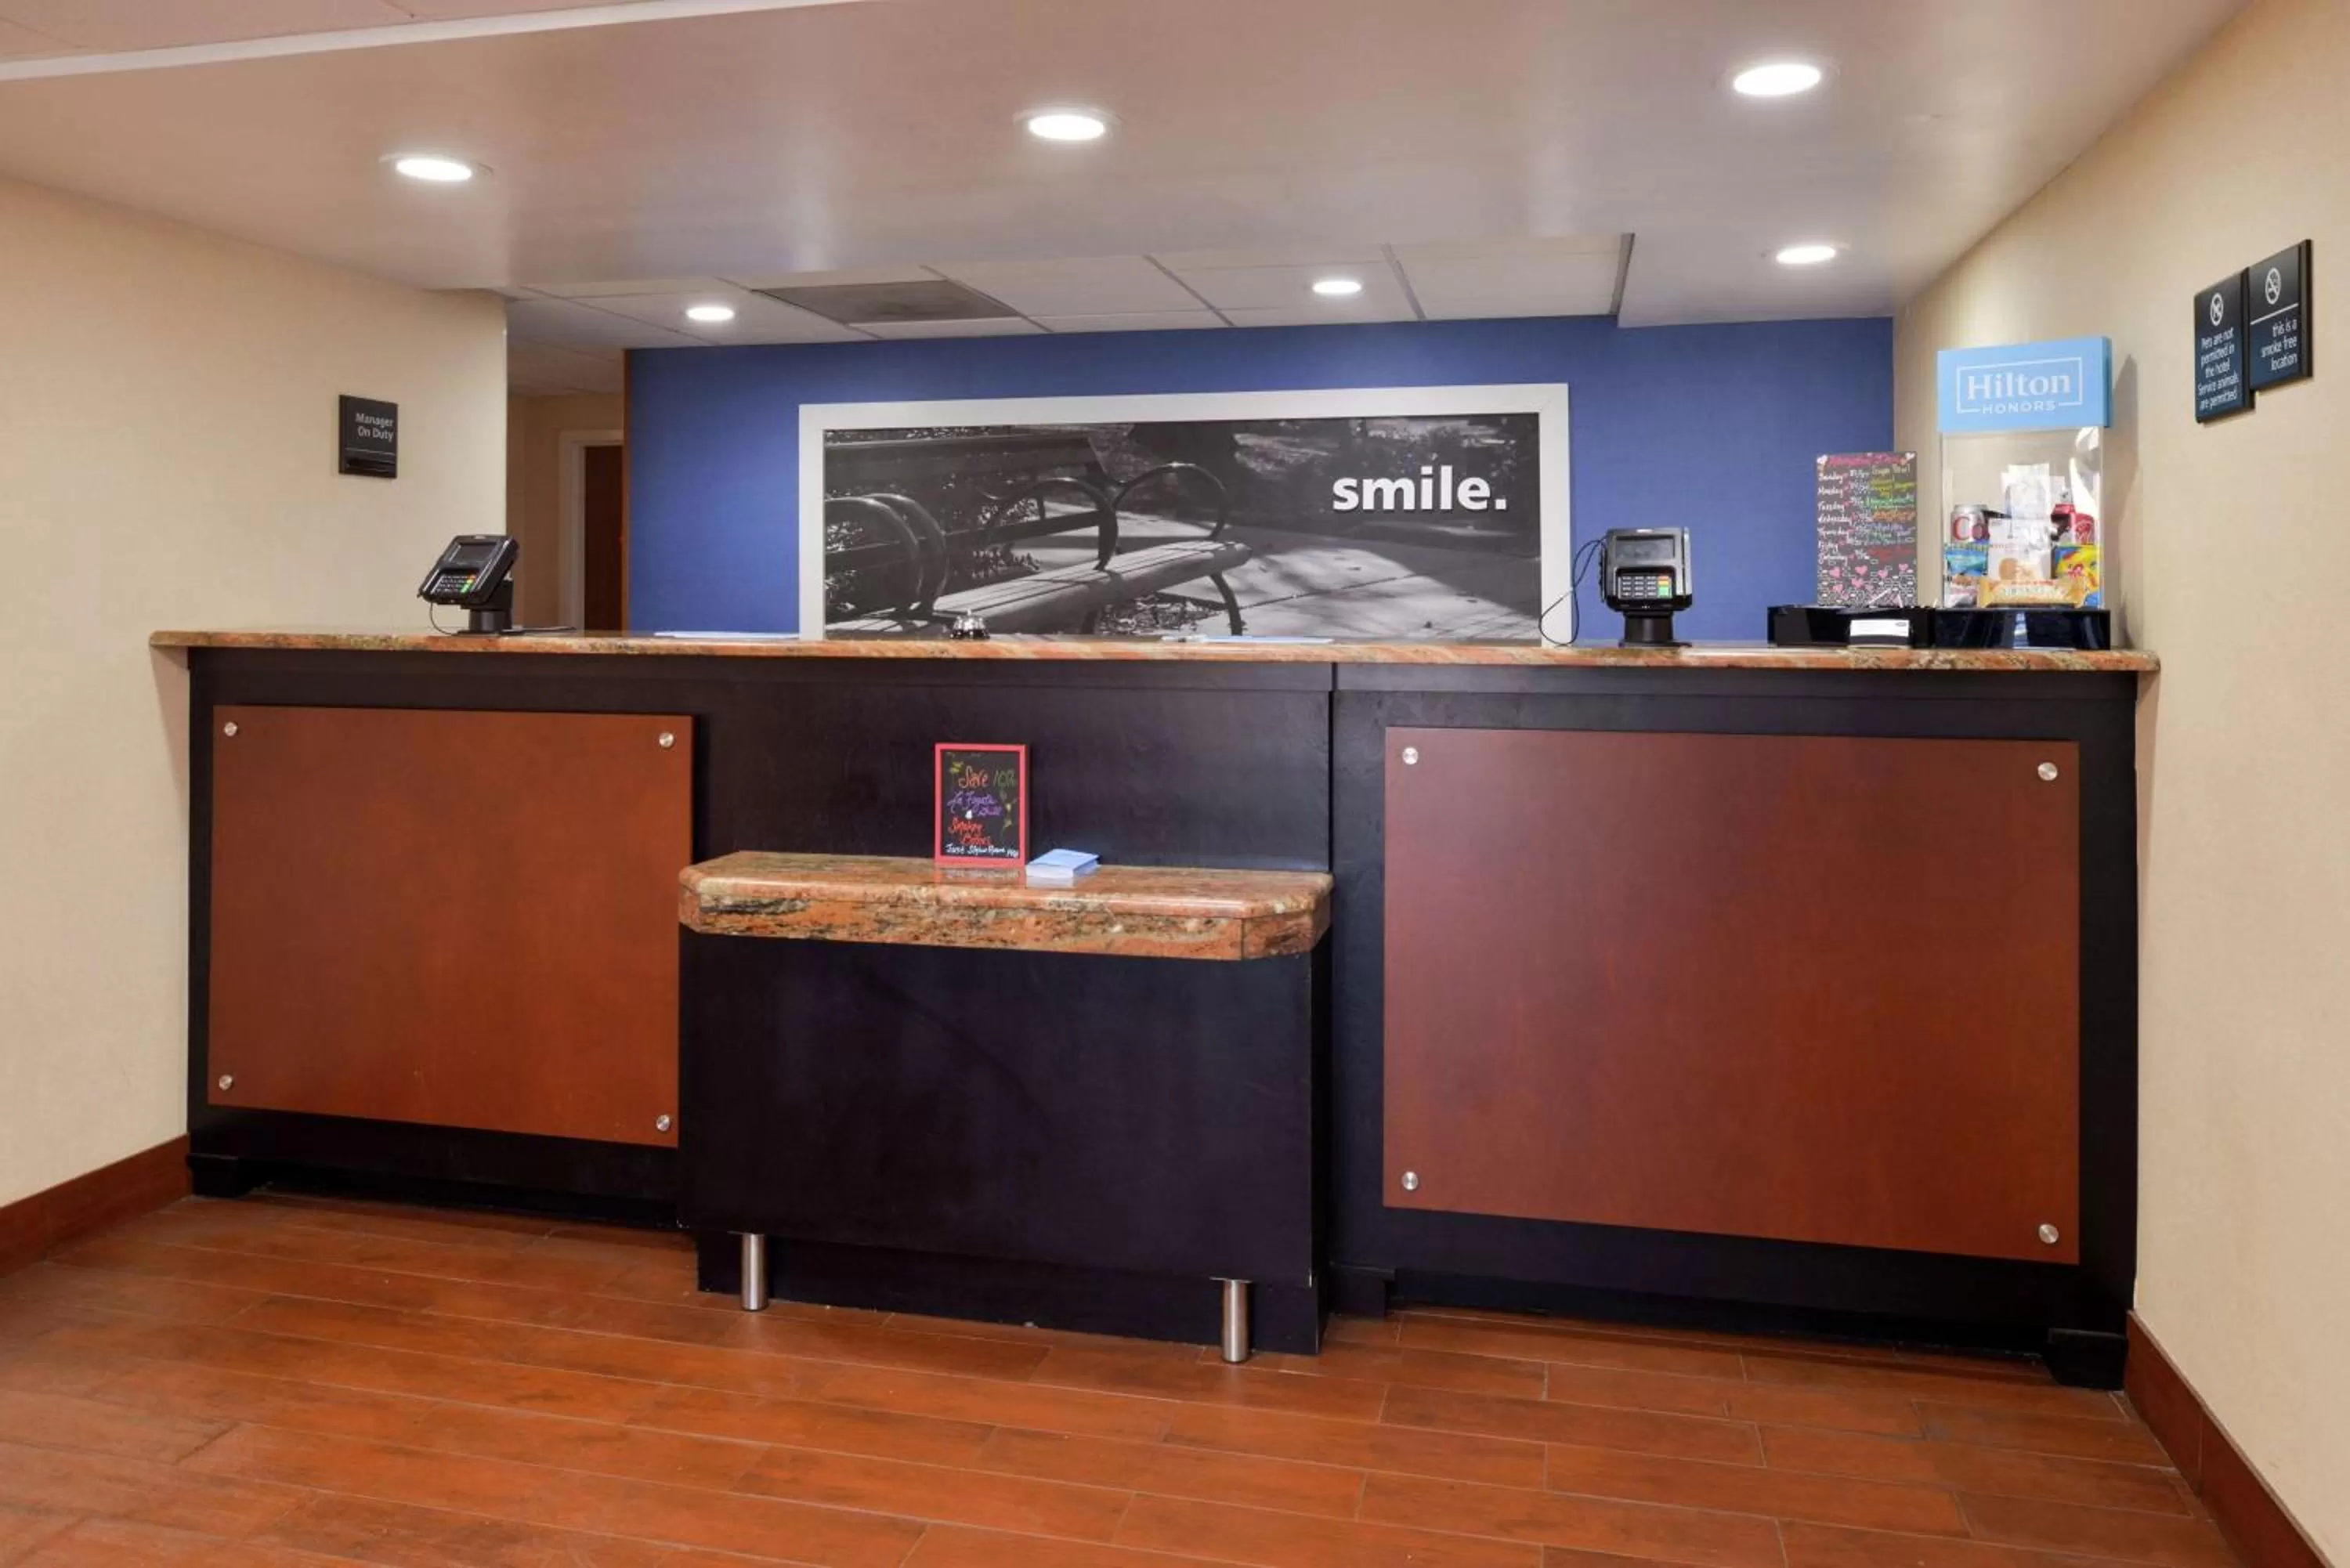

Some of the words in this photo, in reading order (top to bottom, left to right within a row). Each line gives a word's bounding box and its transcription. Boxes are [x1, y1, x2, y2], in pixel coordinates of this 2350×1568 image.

[2272, 320, 2284, 338] this
[2261, 340, 2282, 358] smoke
[2283, 335, 2298, 350] free
[2271, 353, 2298, 370] location
[1967, 371, 2070, 400] Hilton
[1983, 400, 2056, 415] HONORS
[354, 412, 393, 429] Manager
[357, 425, 371, 437] On
[372, 427, 394, 443] Duty
[1332, 464, 1507, 511] smile.
